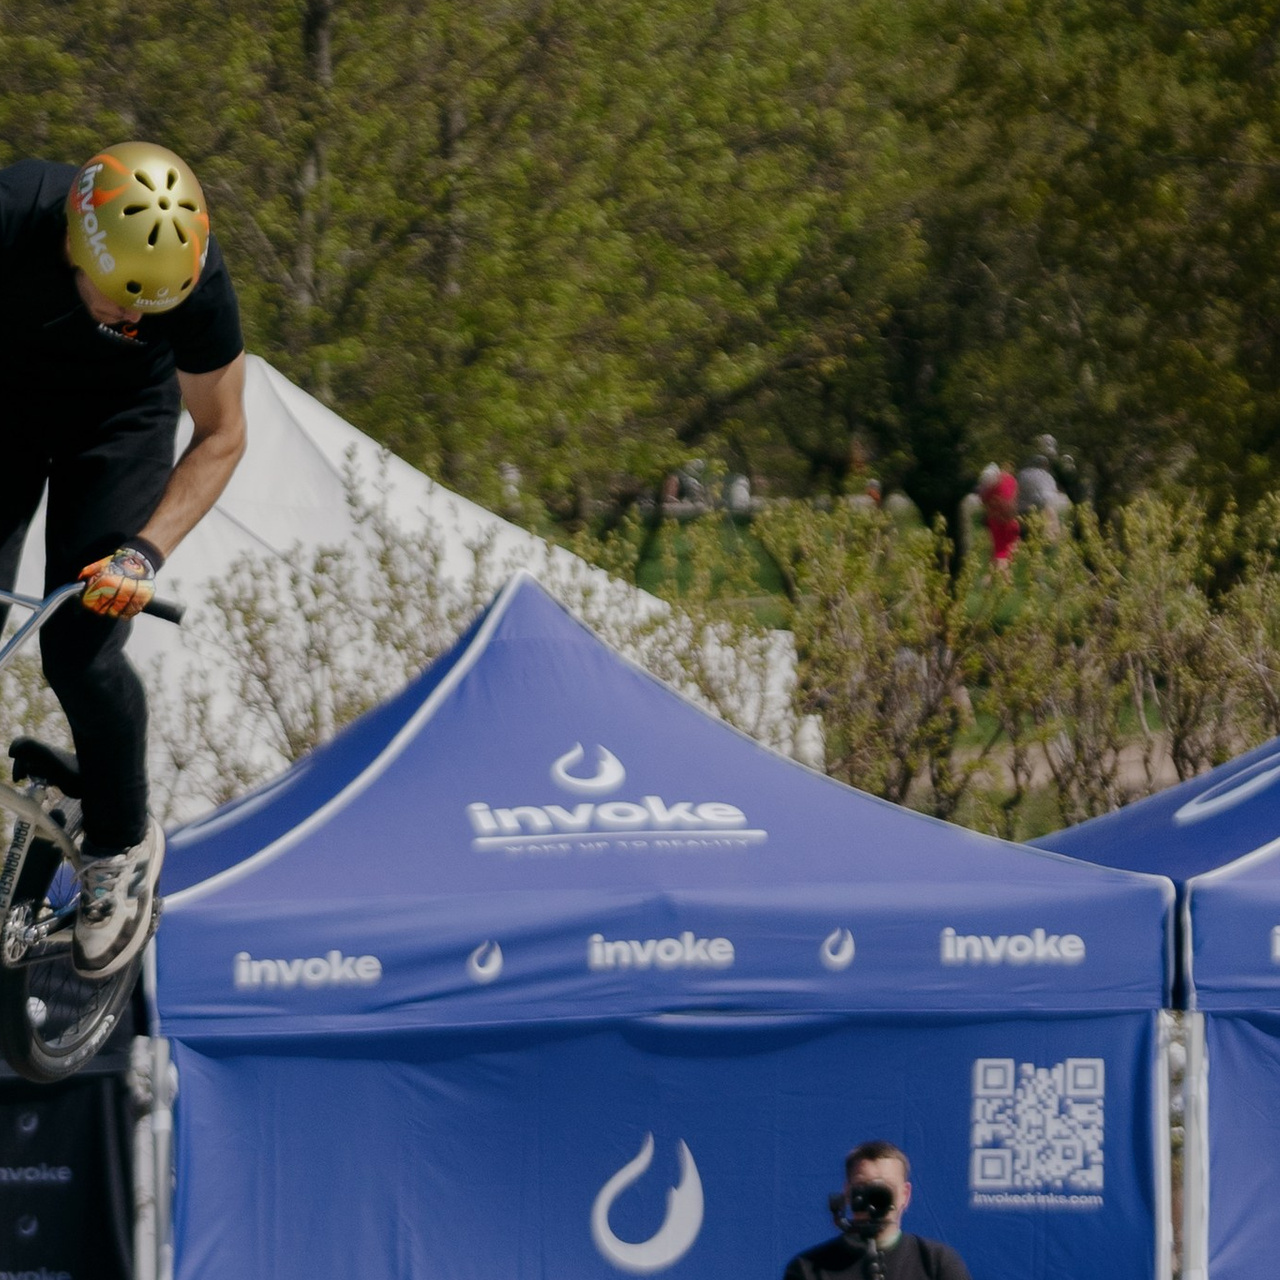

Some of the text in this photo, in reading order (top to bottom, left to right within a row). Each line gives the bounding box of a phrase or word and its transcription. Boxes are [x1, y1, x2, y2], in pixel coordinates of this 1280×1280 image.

[79, 163, 115, 274] invoke
[469, 795, 747, 835] invoke
[617, 839, 650, 851] TO
[235, 927, 1085, 987] invoke invoke invoke
